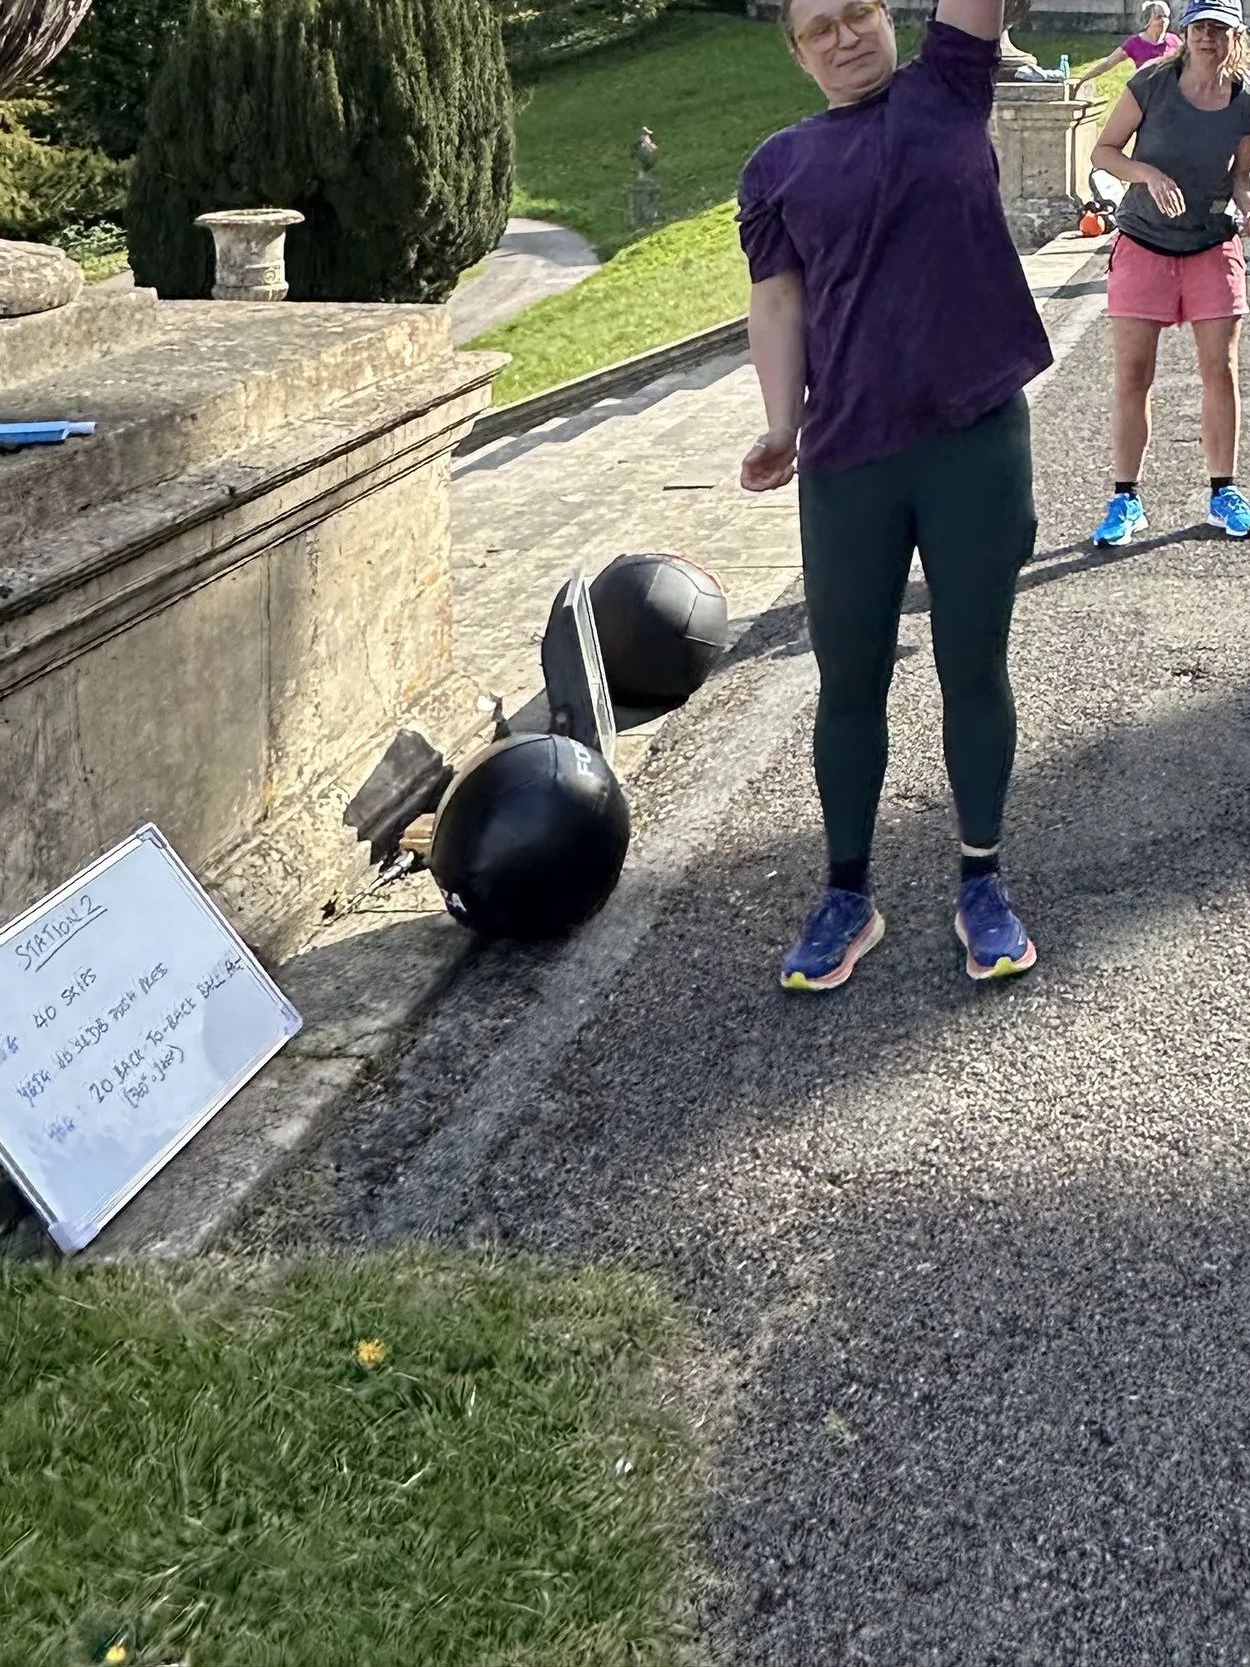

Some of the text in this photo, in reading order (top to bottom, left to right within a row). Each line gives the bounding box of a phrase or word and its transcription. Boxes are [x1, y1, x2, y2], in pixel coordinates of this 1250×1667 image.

[15, 894, 103, 971] STATION 2
[32, 967, 97, 1029] 40 SKIPS
[88, 1077, 114, 1104] 20
